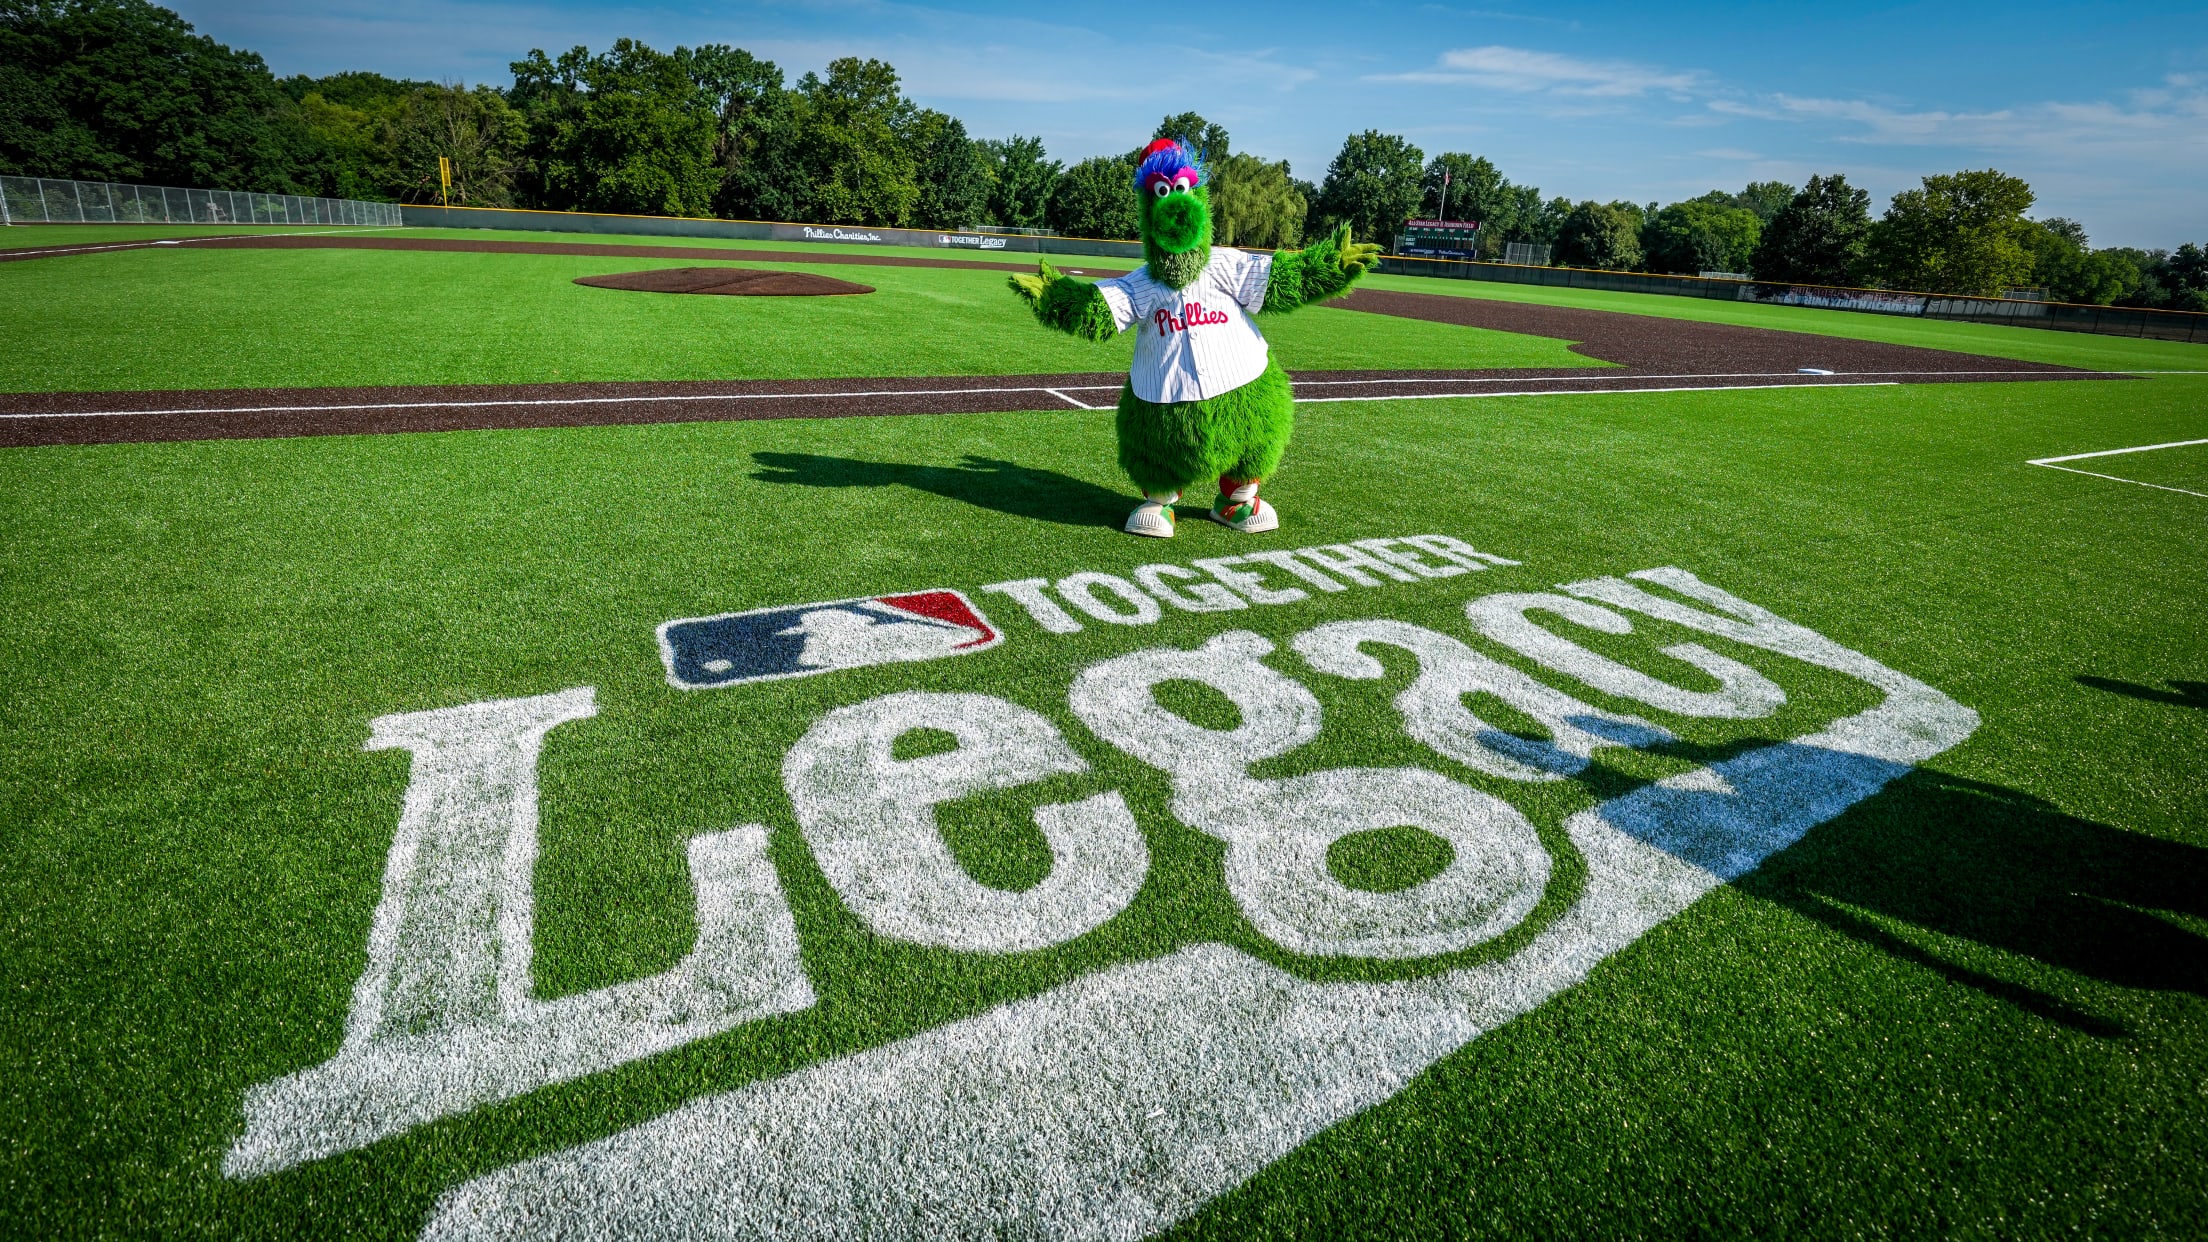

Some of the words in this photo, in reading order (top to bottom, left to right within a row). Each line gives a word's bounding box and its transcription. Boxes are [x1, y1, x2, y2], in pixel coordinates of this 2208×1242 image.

[803, 226, 833, 239] Phillies
[951, 235, 979, 245] TOGETHER
[979, 235, 1007, 248] Legacy
[1154, 302, 1229, 337] Phillies
[981, 534, 1523, 634] TOGETHER
[222, 565, 1982, 1242] Legacy
